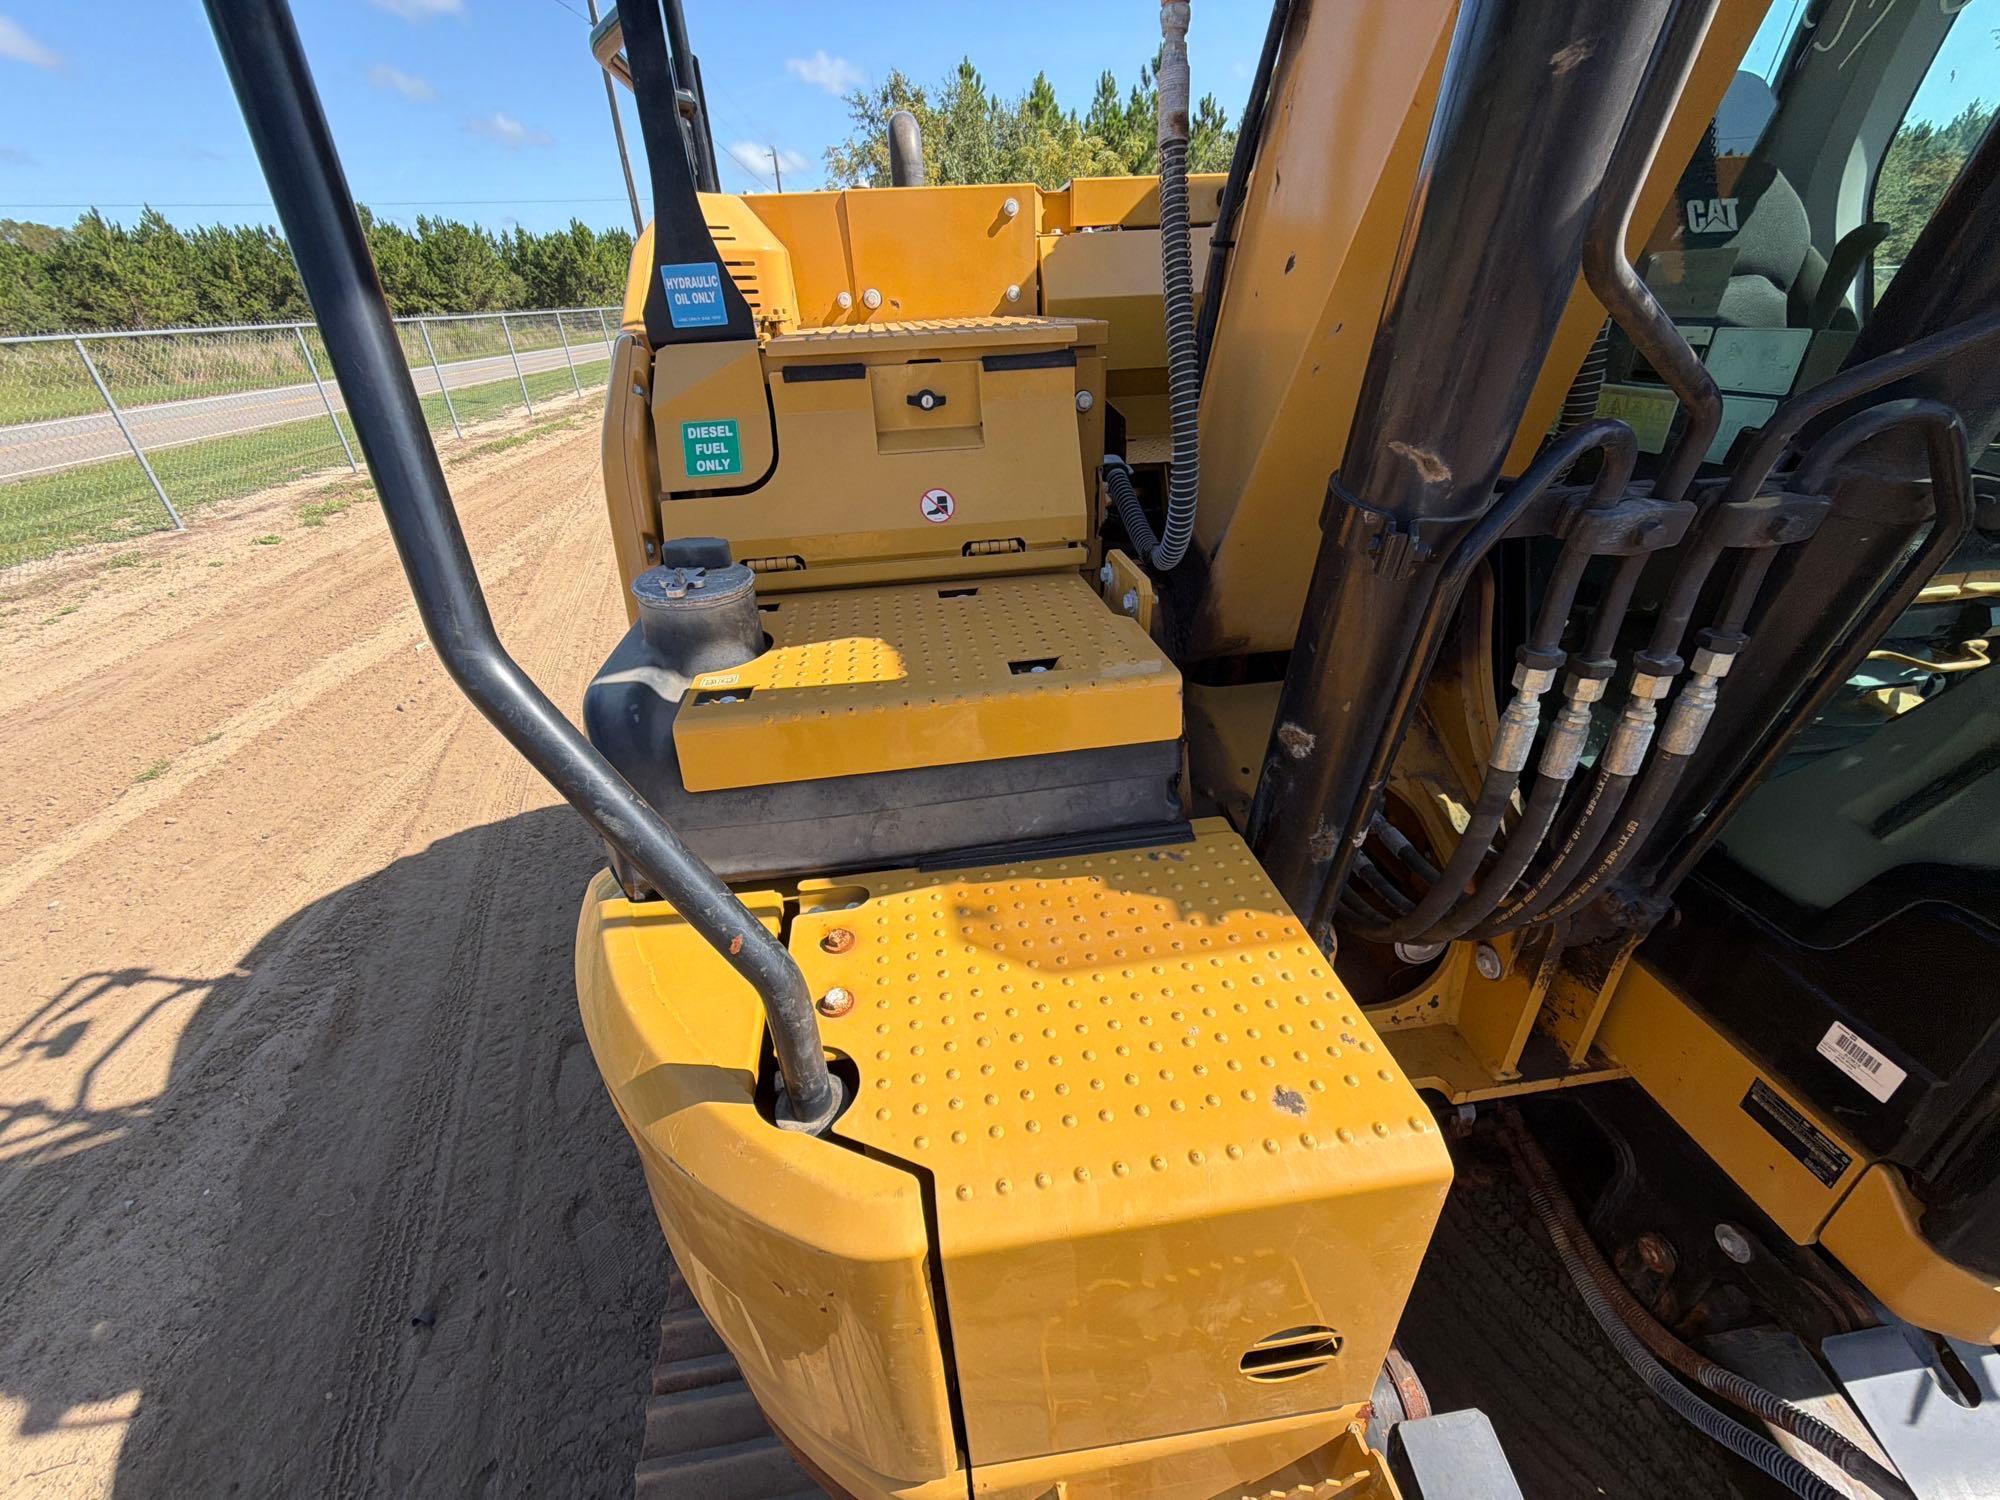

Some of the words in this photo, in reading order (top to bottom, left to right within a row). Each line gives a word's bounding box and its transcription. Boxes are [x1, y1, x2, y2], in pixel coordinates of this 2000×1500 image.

[1686, 197, 1739, 233] CAT
[665, 275, 719, 290] HYDRAULIC
[674, 292, 691, 305] OIL
[691, 291, 716, 304] ONLY
[687, 425, 734, 439] DIESEL
[695, 442, 729, 455] FUEL
[696, 458, 731, 472] ONLY
